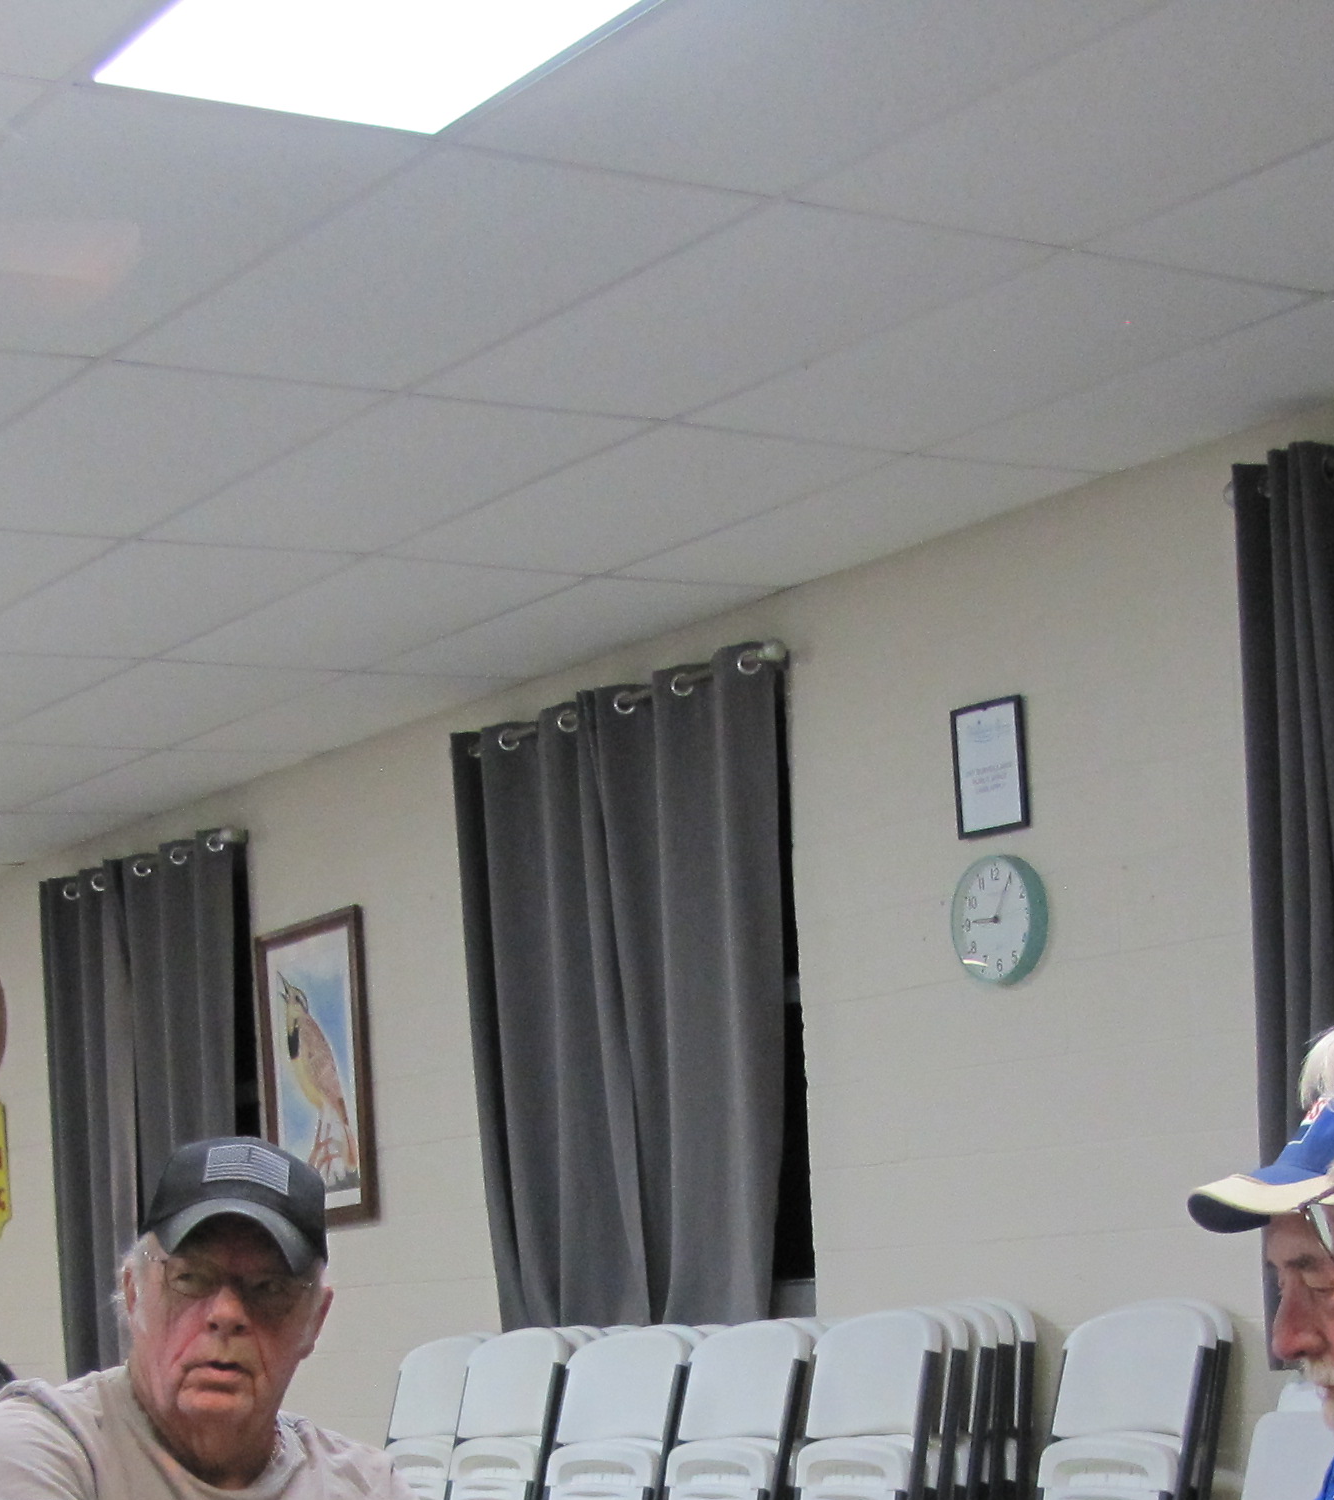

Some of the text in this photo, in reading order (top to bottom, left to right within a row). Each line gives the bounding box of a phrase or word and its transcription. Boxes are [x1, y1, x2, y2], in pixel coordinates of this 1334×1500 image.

[990, 867, 999, 880] 12
[978, 878, 985, 890] 11
[996, 958, 1003, 972] 6
